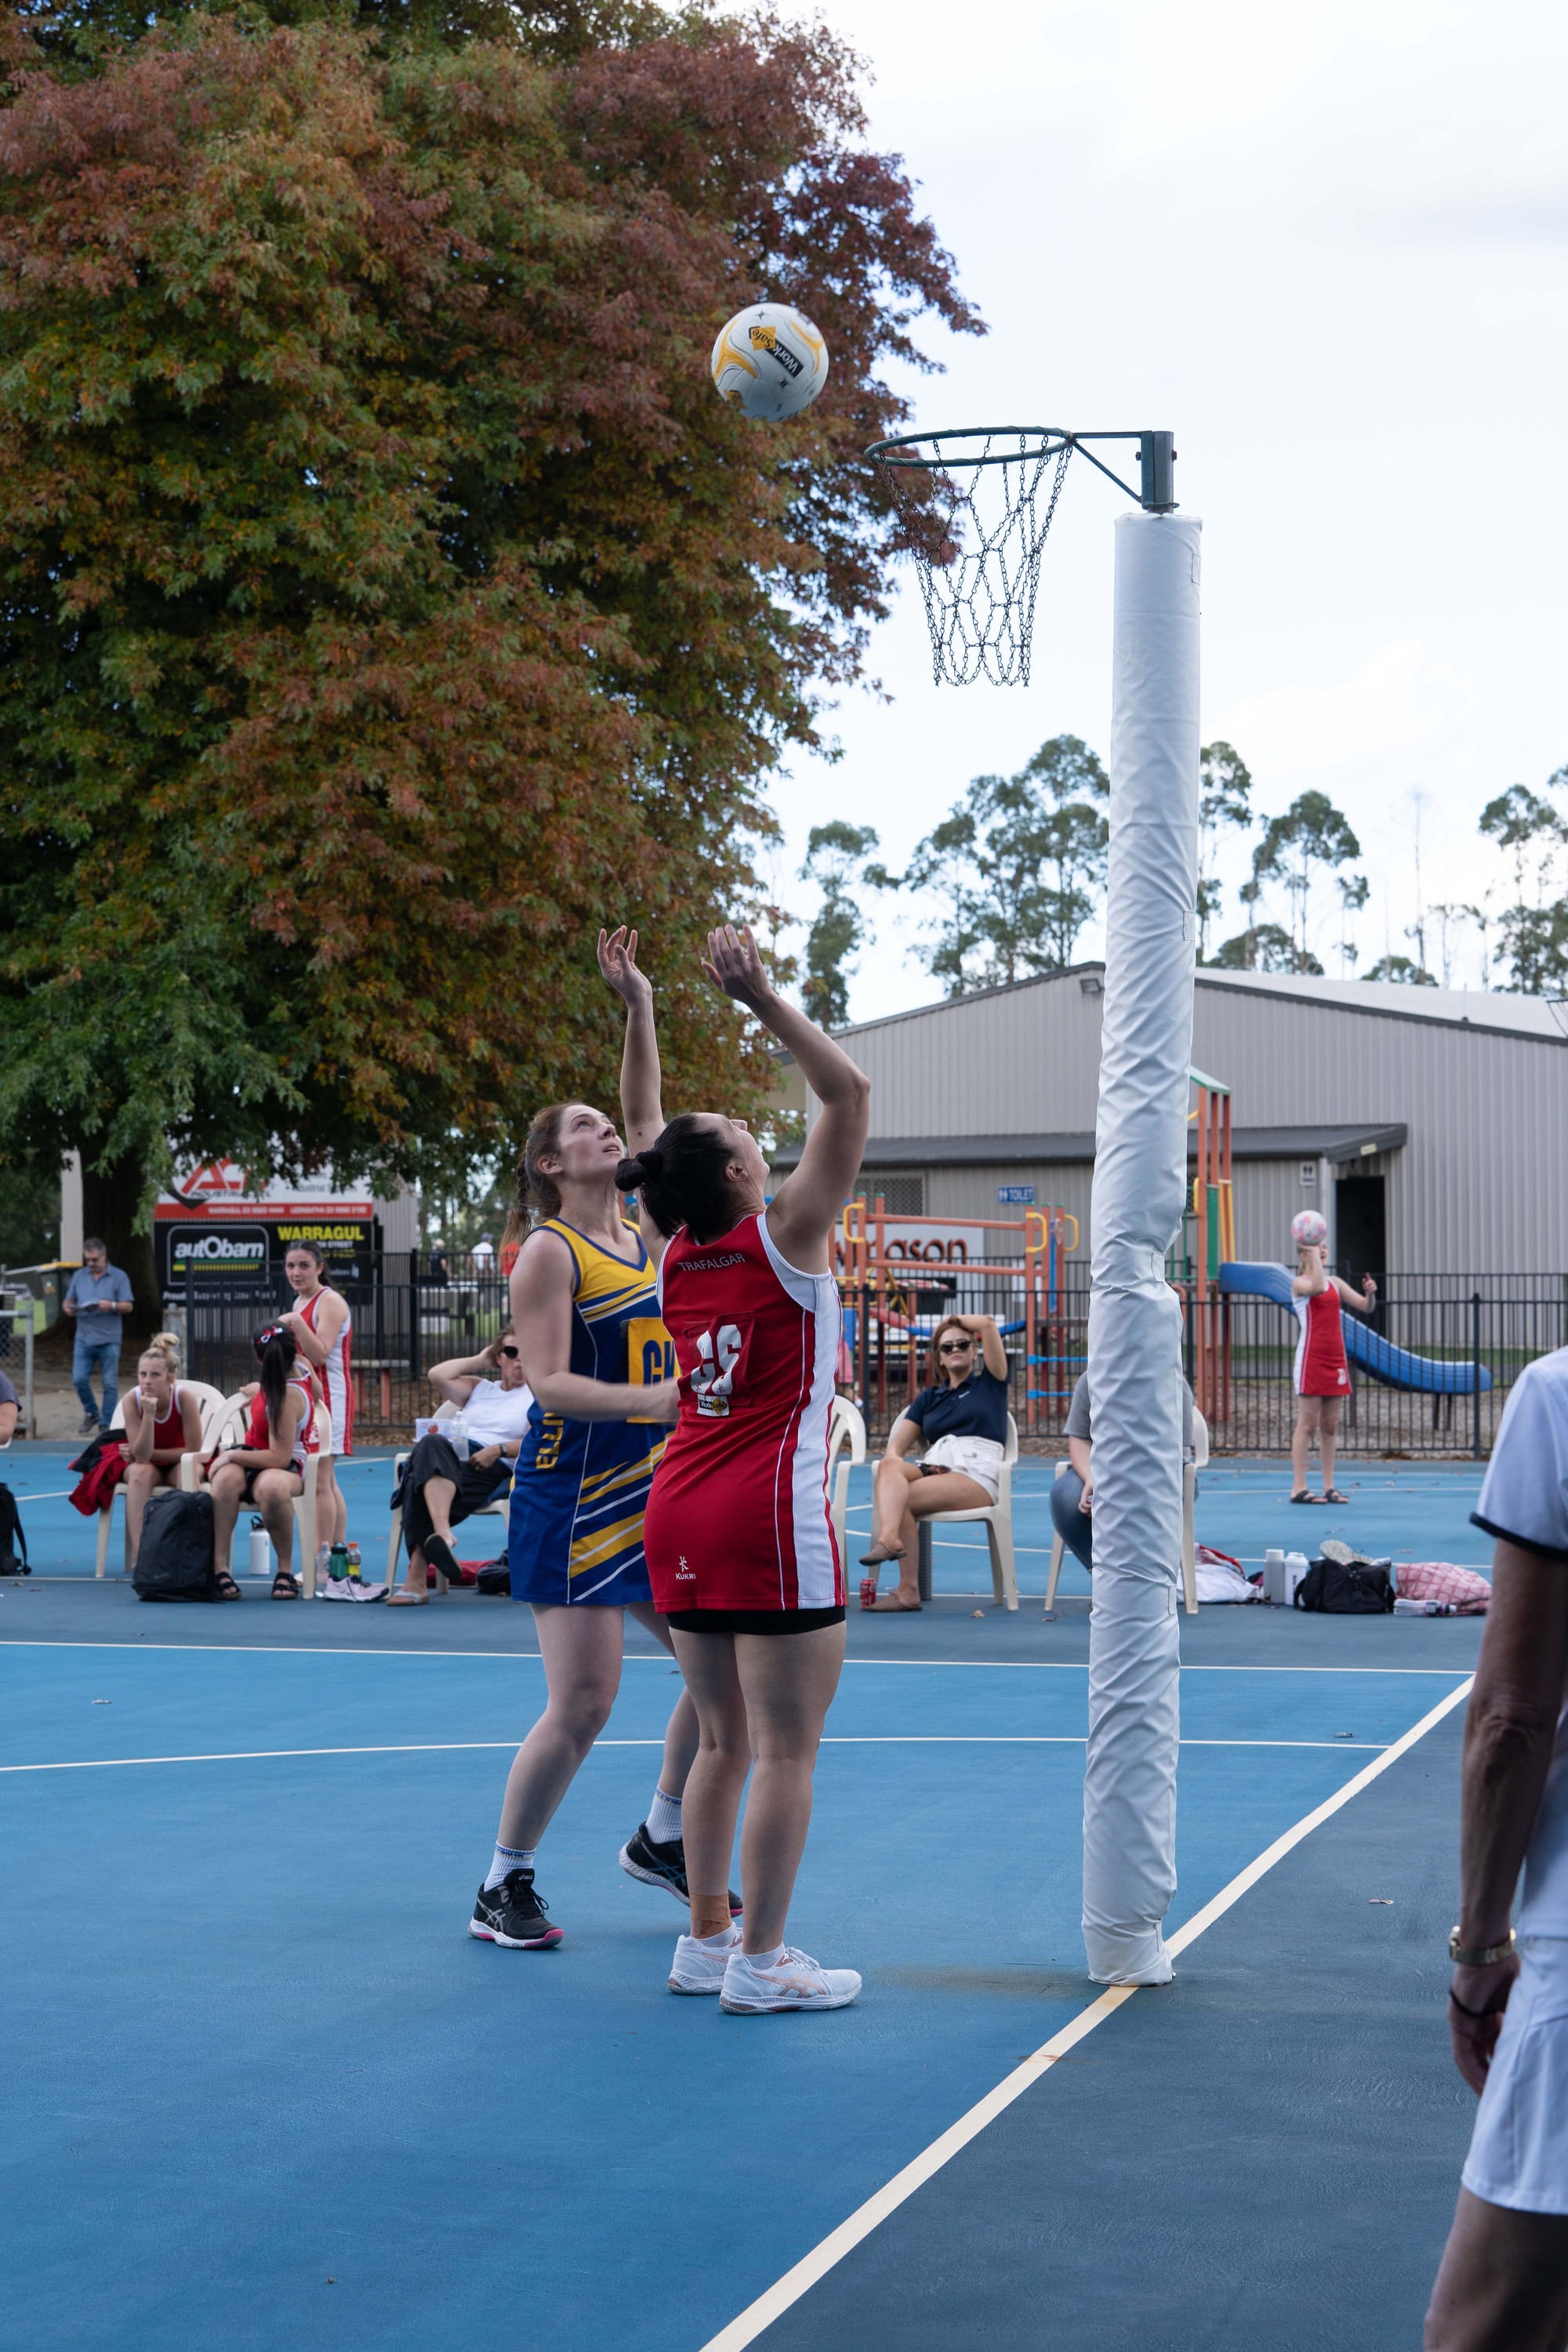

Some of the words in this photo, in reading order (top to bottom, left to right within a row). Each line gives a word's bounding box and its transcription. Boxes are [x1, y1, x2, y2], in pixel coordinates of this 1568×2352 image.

[1008, 1189, 1033, 1201] TOILET
[277, 1225, 365, 1241] WARRAGUL
[677, 1253, 746, 1272] TRAFALGAR
